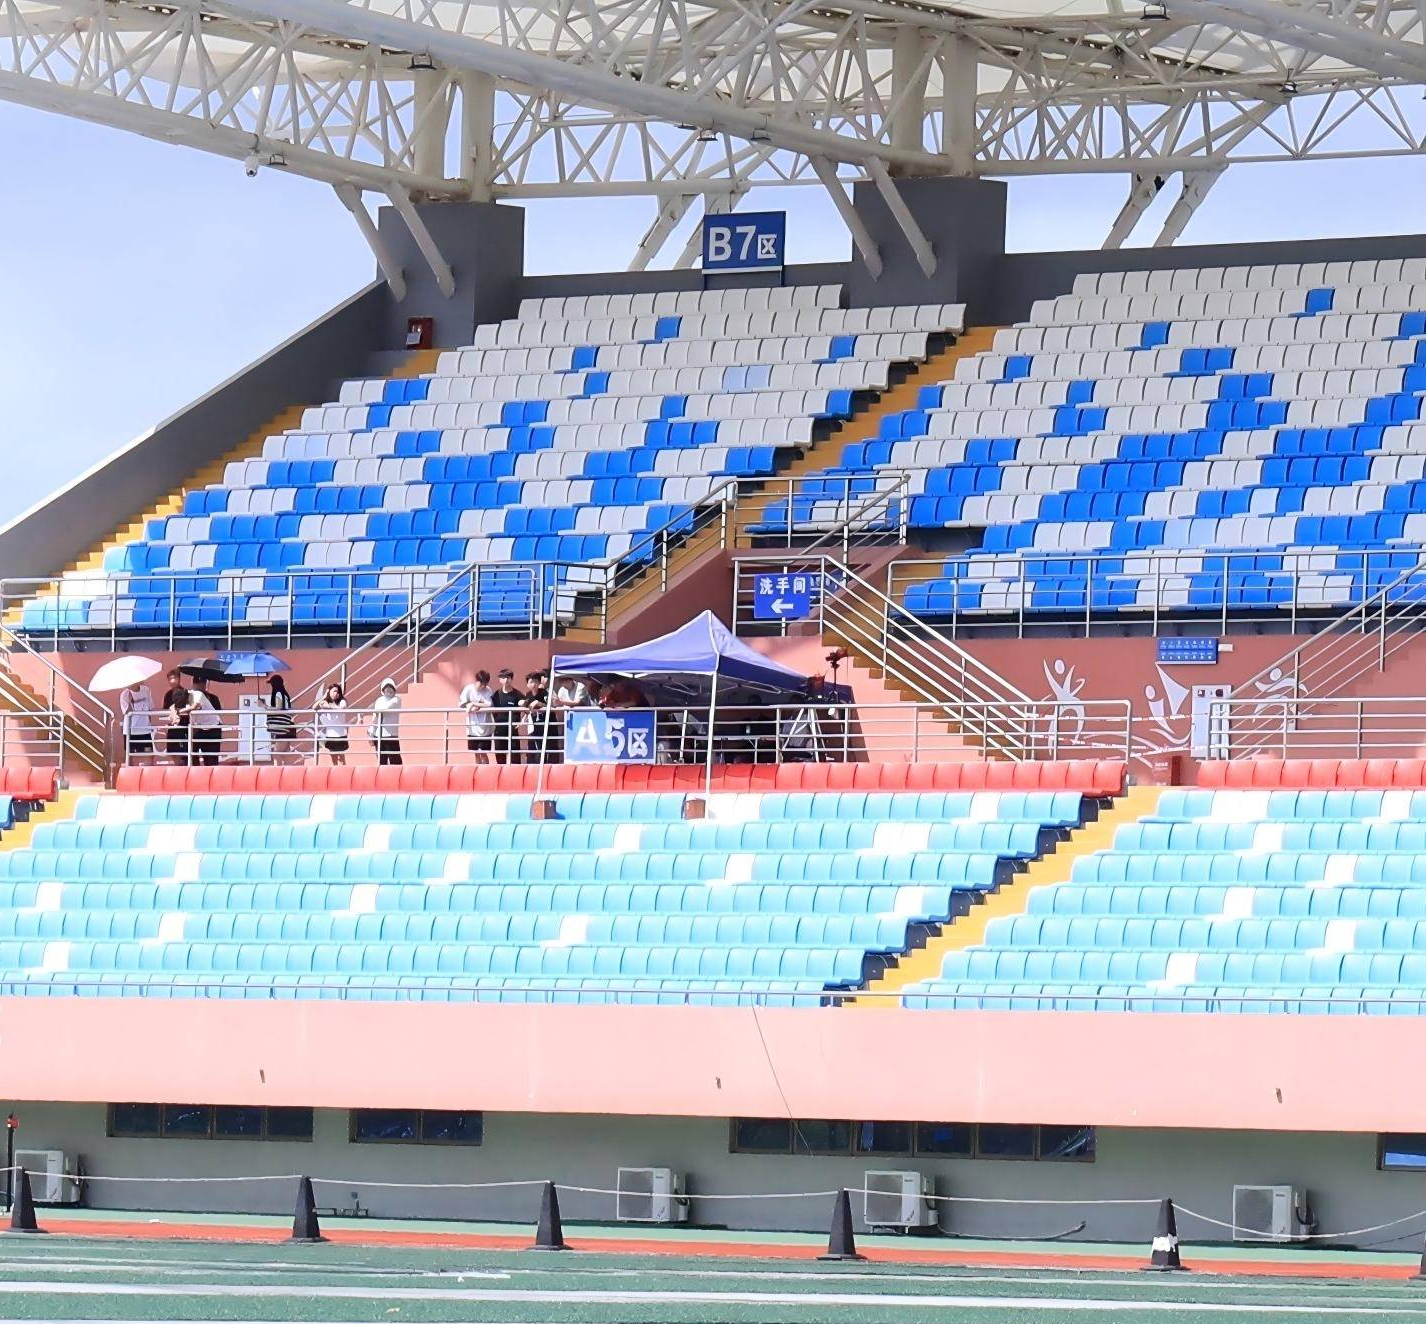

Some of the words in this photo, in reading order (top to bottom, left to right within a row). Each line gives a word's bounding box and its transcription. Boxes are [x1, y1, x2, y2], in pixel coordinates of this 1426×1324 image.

[708, 225, 778, 262] B7区
[759, 575, 806, 595] 洗手间
[572, 718, 650, 758] A5区
